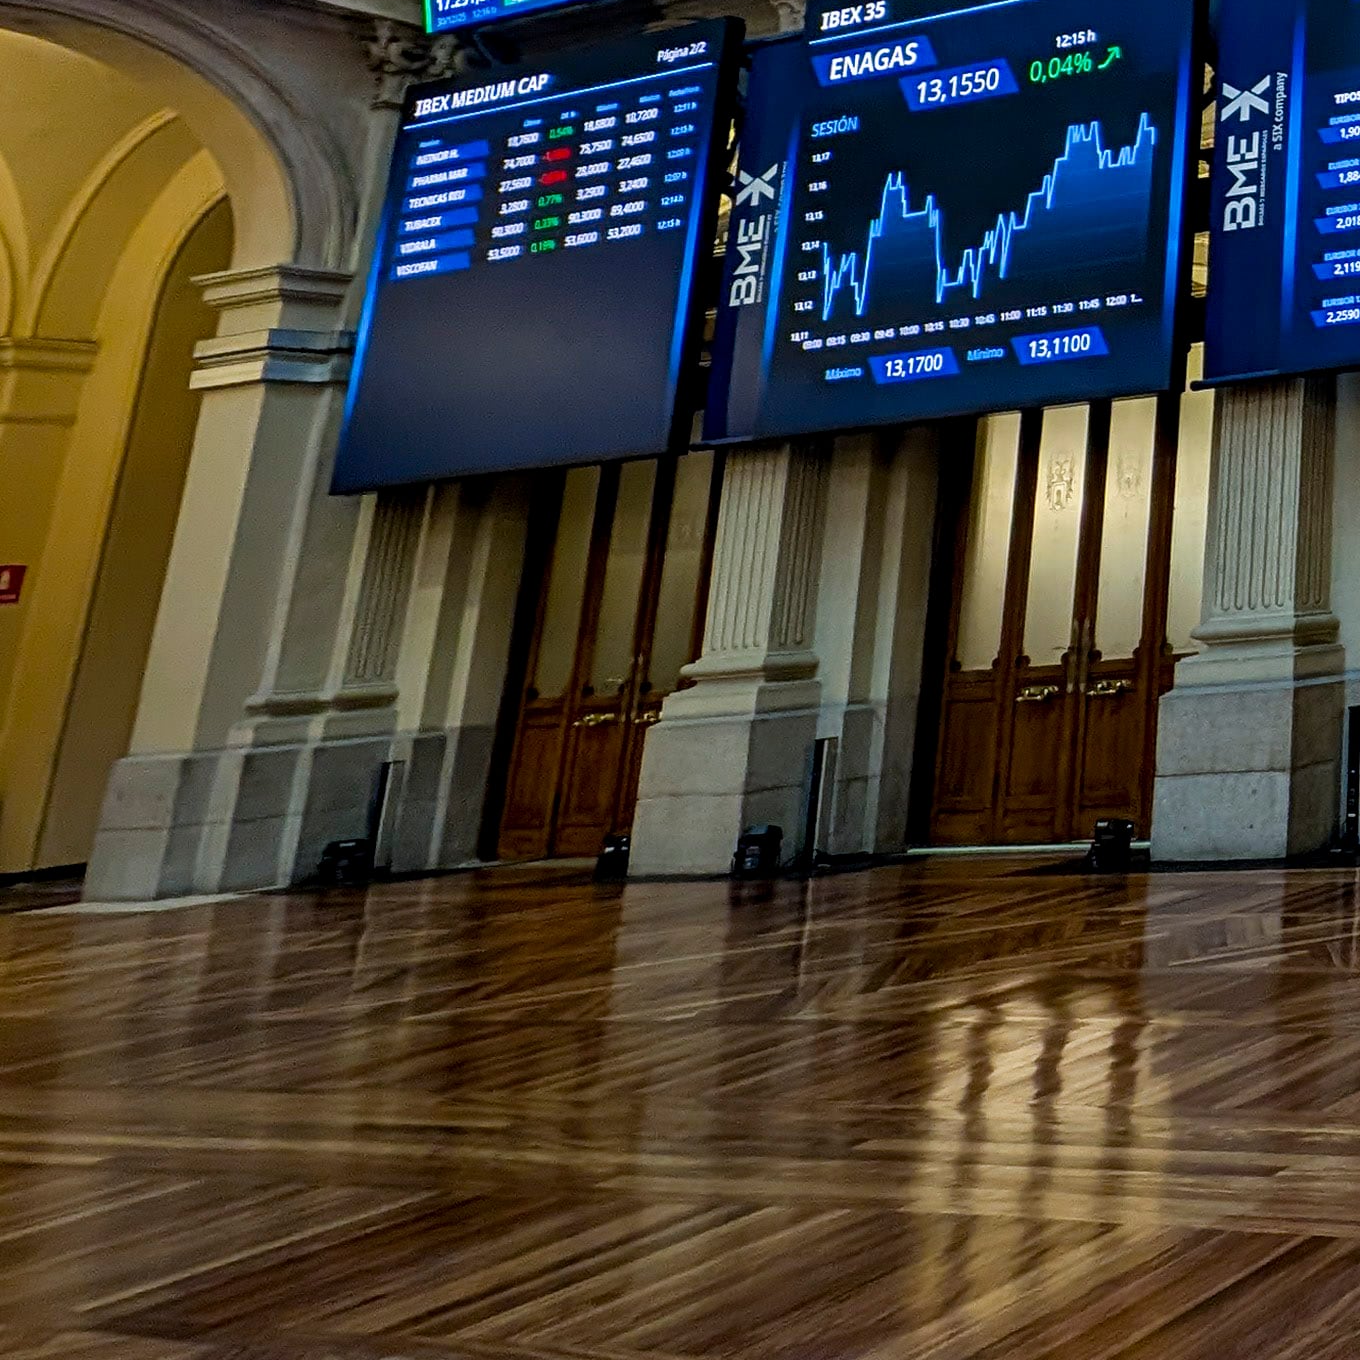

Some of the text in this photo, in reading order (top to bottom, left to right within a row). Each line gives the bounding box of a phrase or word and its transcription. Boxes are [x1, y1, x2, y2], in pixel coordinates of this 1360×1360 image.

[821, 0, 886, 31] IBEX 35
[657, 41, 707, 63] Página 2/2
[1055, 32, 1086, 49] 12:15
[829, 42, 919, 81] ENAGAS
[1030, 51, 1092, 83] 0,04%
[415, 93, 449, 117] IBEX
[451, 80, 515, 107] MEDIUM
[517, 73, 549, 94] CAP
[917, 68, 1000, 104] 13,1550
[1272, 72, 1288, 141] SIX company
[811, 114, 858, 137] SESIÓN
[1223, 131, 1260, 231] BME
[729, 214, 766, 307] BME
[1326, 308, 1360, 324] 2,2590
[884, 353, 943, 378] 13,1700
[1028, 333, 1091, 359] 13,1100
